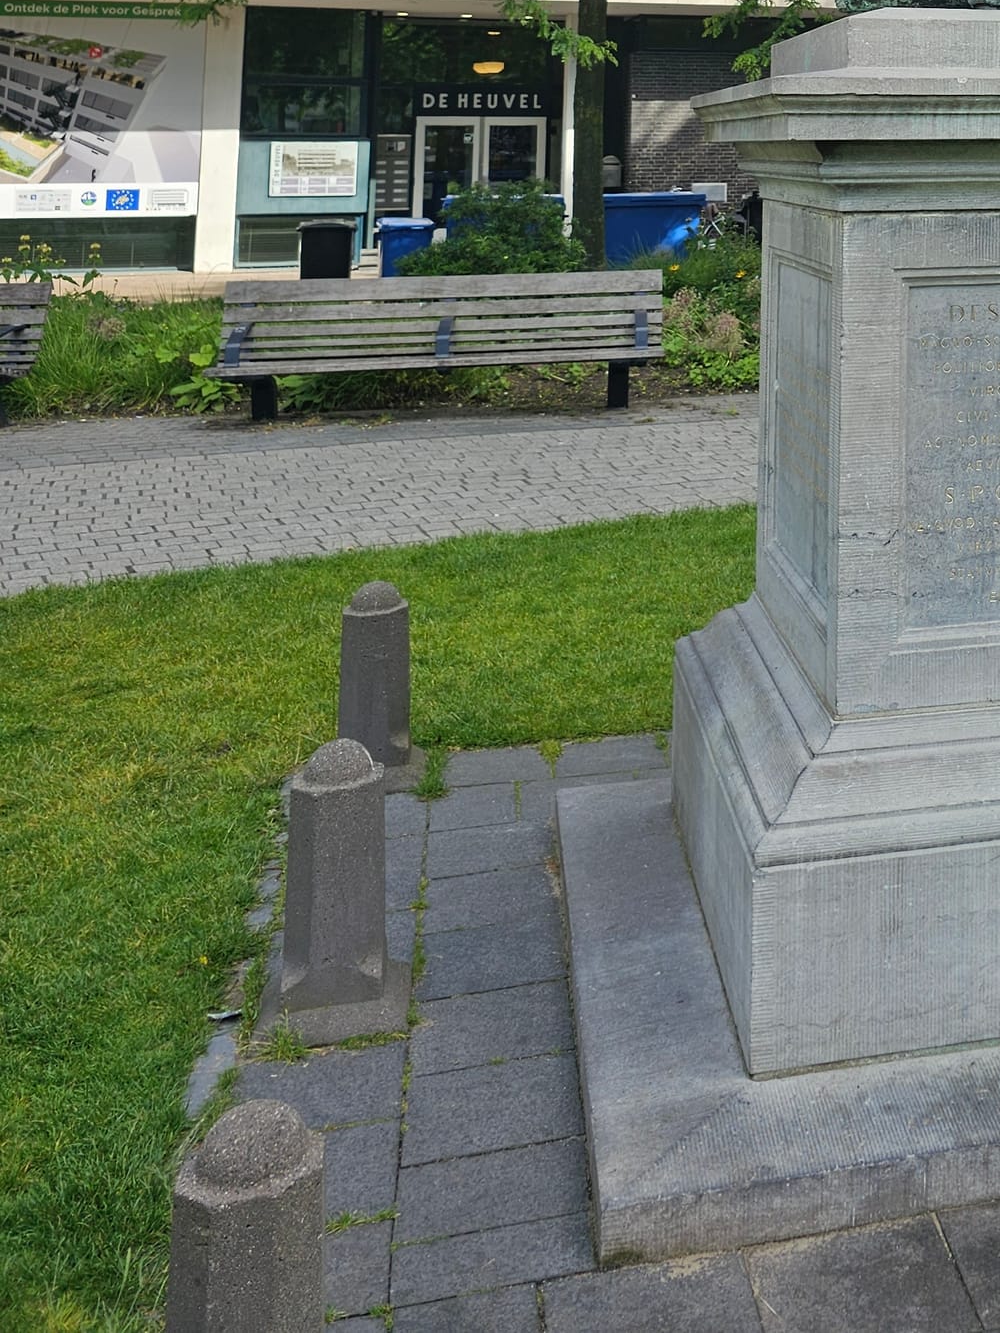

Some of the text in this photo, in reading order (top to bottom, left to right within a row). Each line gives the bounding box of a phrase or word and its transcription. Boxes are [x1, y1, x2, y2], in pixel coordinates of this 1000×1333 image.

[4, 3, 182, 17] Ontdek de Plek voor Gesprek
[423, 93, 542, 109] DE HEUVEL
[955, 409, 989, 423] CIVI
[945, 486, 955, 505] S
[968, 485, 984, 502] P
